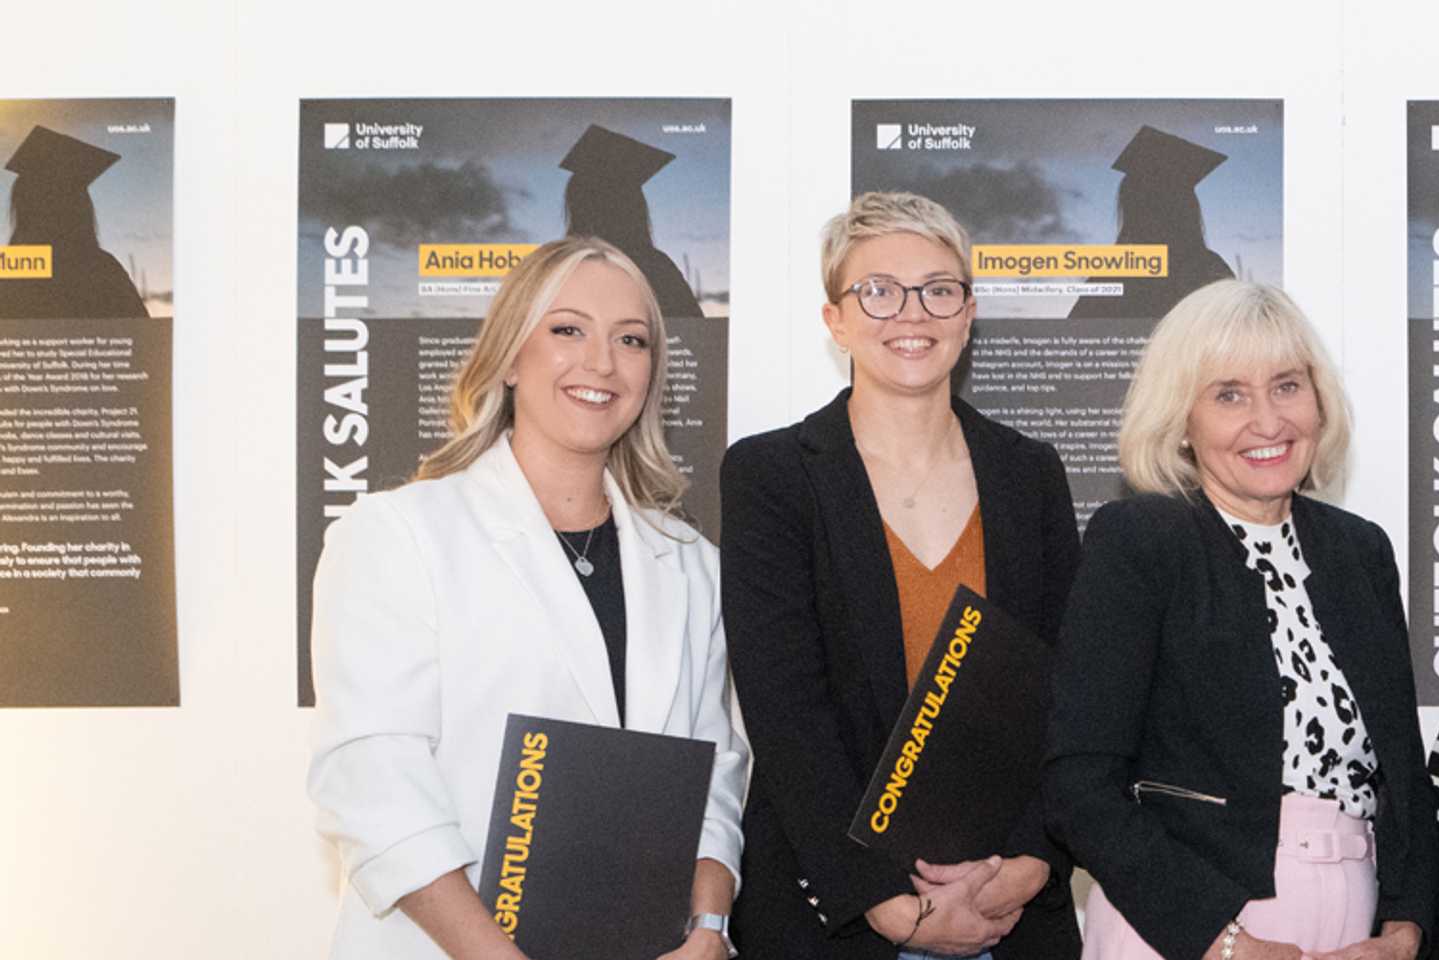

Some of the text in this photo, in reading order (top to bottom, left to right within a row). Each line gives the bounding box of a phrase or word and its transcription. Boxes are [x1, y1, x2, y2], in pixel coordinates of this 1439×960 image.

[356, 123, 423, 137] University
[909, 124, 975, 137] University
[356, 136, 418, 149] of Suffolk
[908, 137, 970, 149] of Suffolk
[426, 250, 522, 269] Ania Hob
[979, 251, 1161, 274] Imogen Snowling
[323, 226, 369, 446] SALUTES
[870, 605, 983, 833] CONGRATULATIONS
